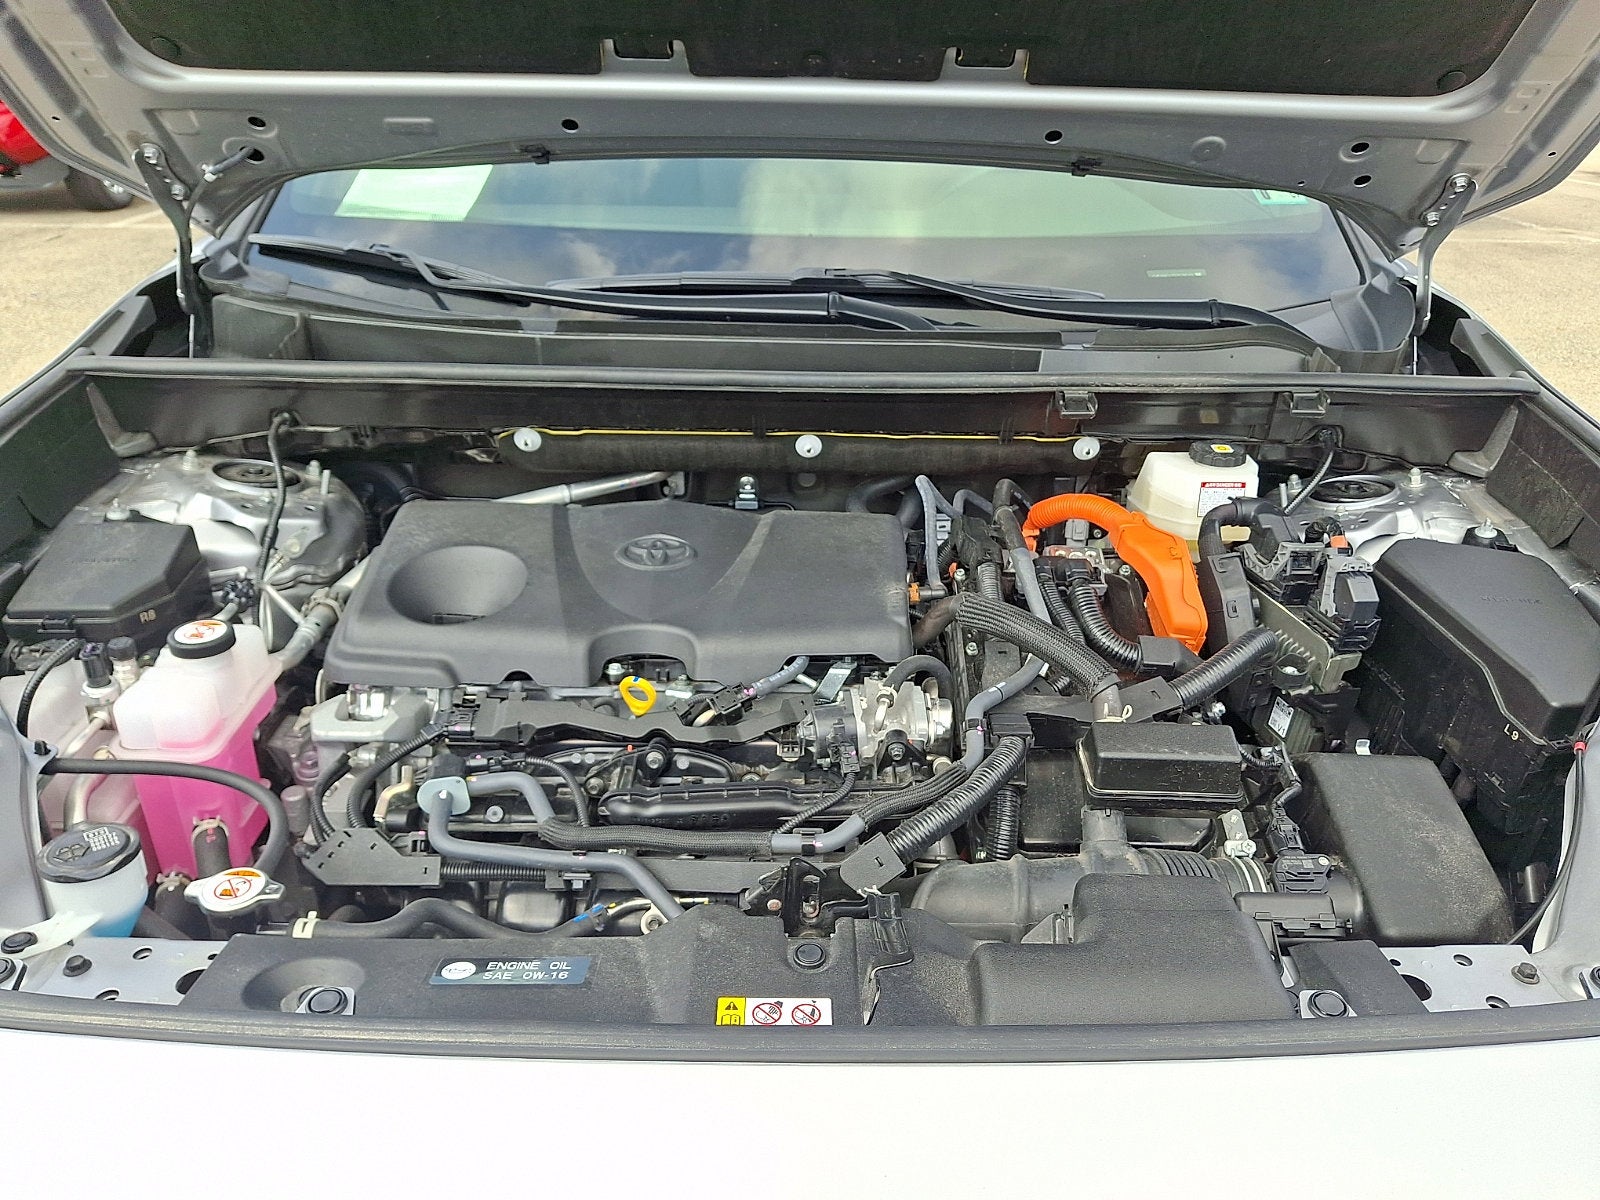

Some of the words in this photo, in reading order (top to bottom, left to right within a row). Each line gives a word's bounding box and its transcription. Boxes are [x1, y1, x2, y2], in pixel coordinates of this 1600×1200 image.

[486, 961, 541, 970] ENGINE
[549, 961, 572, 970] OIL
[482, 971, 514, 980] SAE
